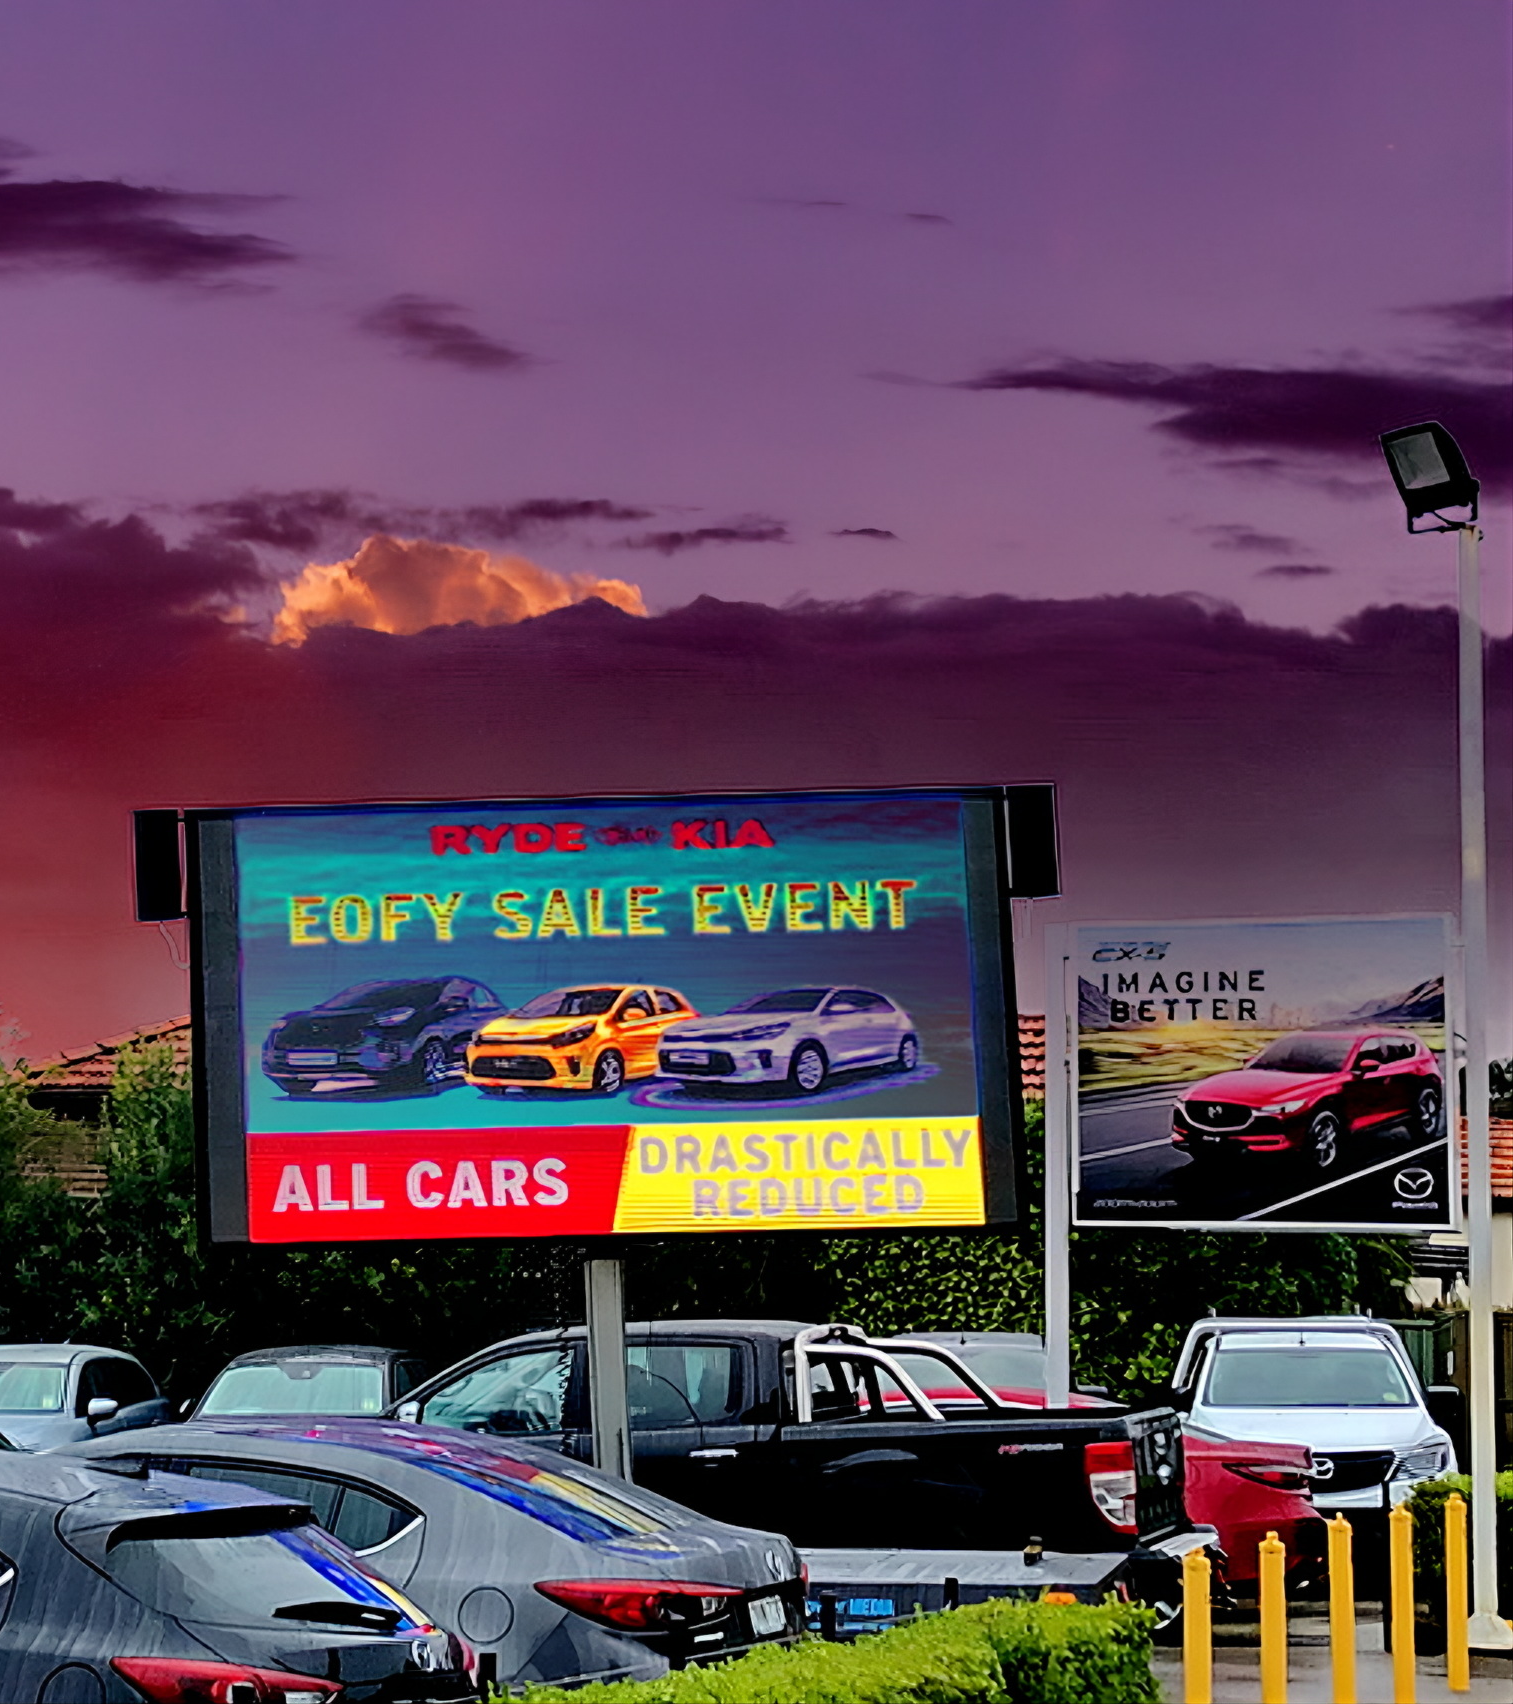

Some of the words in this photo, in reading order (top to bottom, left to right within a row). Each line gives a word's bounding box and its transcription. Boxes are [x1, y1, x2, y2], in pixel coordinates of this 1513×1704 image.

[429, 823, 586, 855] RYDE
[670, 819, 776, 850] KIA
[289, 892, 463, 946] EOFY
[492, 885, 666, 939] SALE
[692, 880, 916, 934] EVENT
[1102, 970, 1265, 994] IMAGINE
[1110, 998, 1257, 1023] BETTER
[639, 1129, 972, 1174] DRASTICALLY
[272, 1163, 385, 1212] ALL
[406, 1158, 569, 1208] CARS
[692, 1174, 924, 1217] REDUCED
